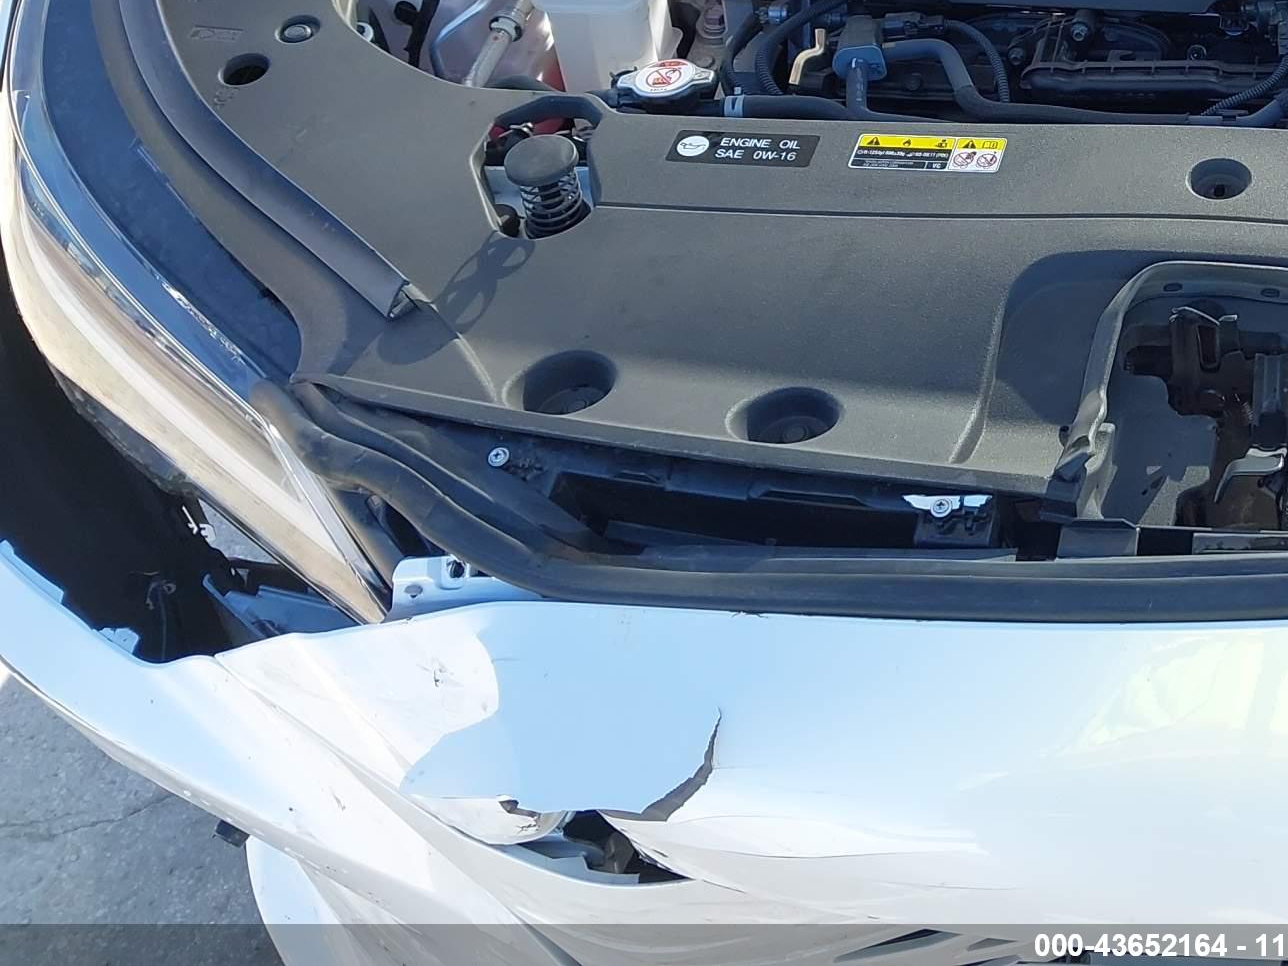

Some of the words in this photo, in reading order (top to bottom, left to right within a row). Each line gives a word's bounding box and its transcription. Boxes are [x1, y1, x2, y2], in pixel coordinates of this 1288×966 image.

[720, 137, 772, 148] ENGINE
[779, 139, 801, 149] OIL
[715, 149, 745, 159] SAE
[753, 150, 797, 161] 0W-16
